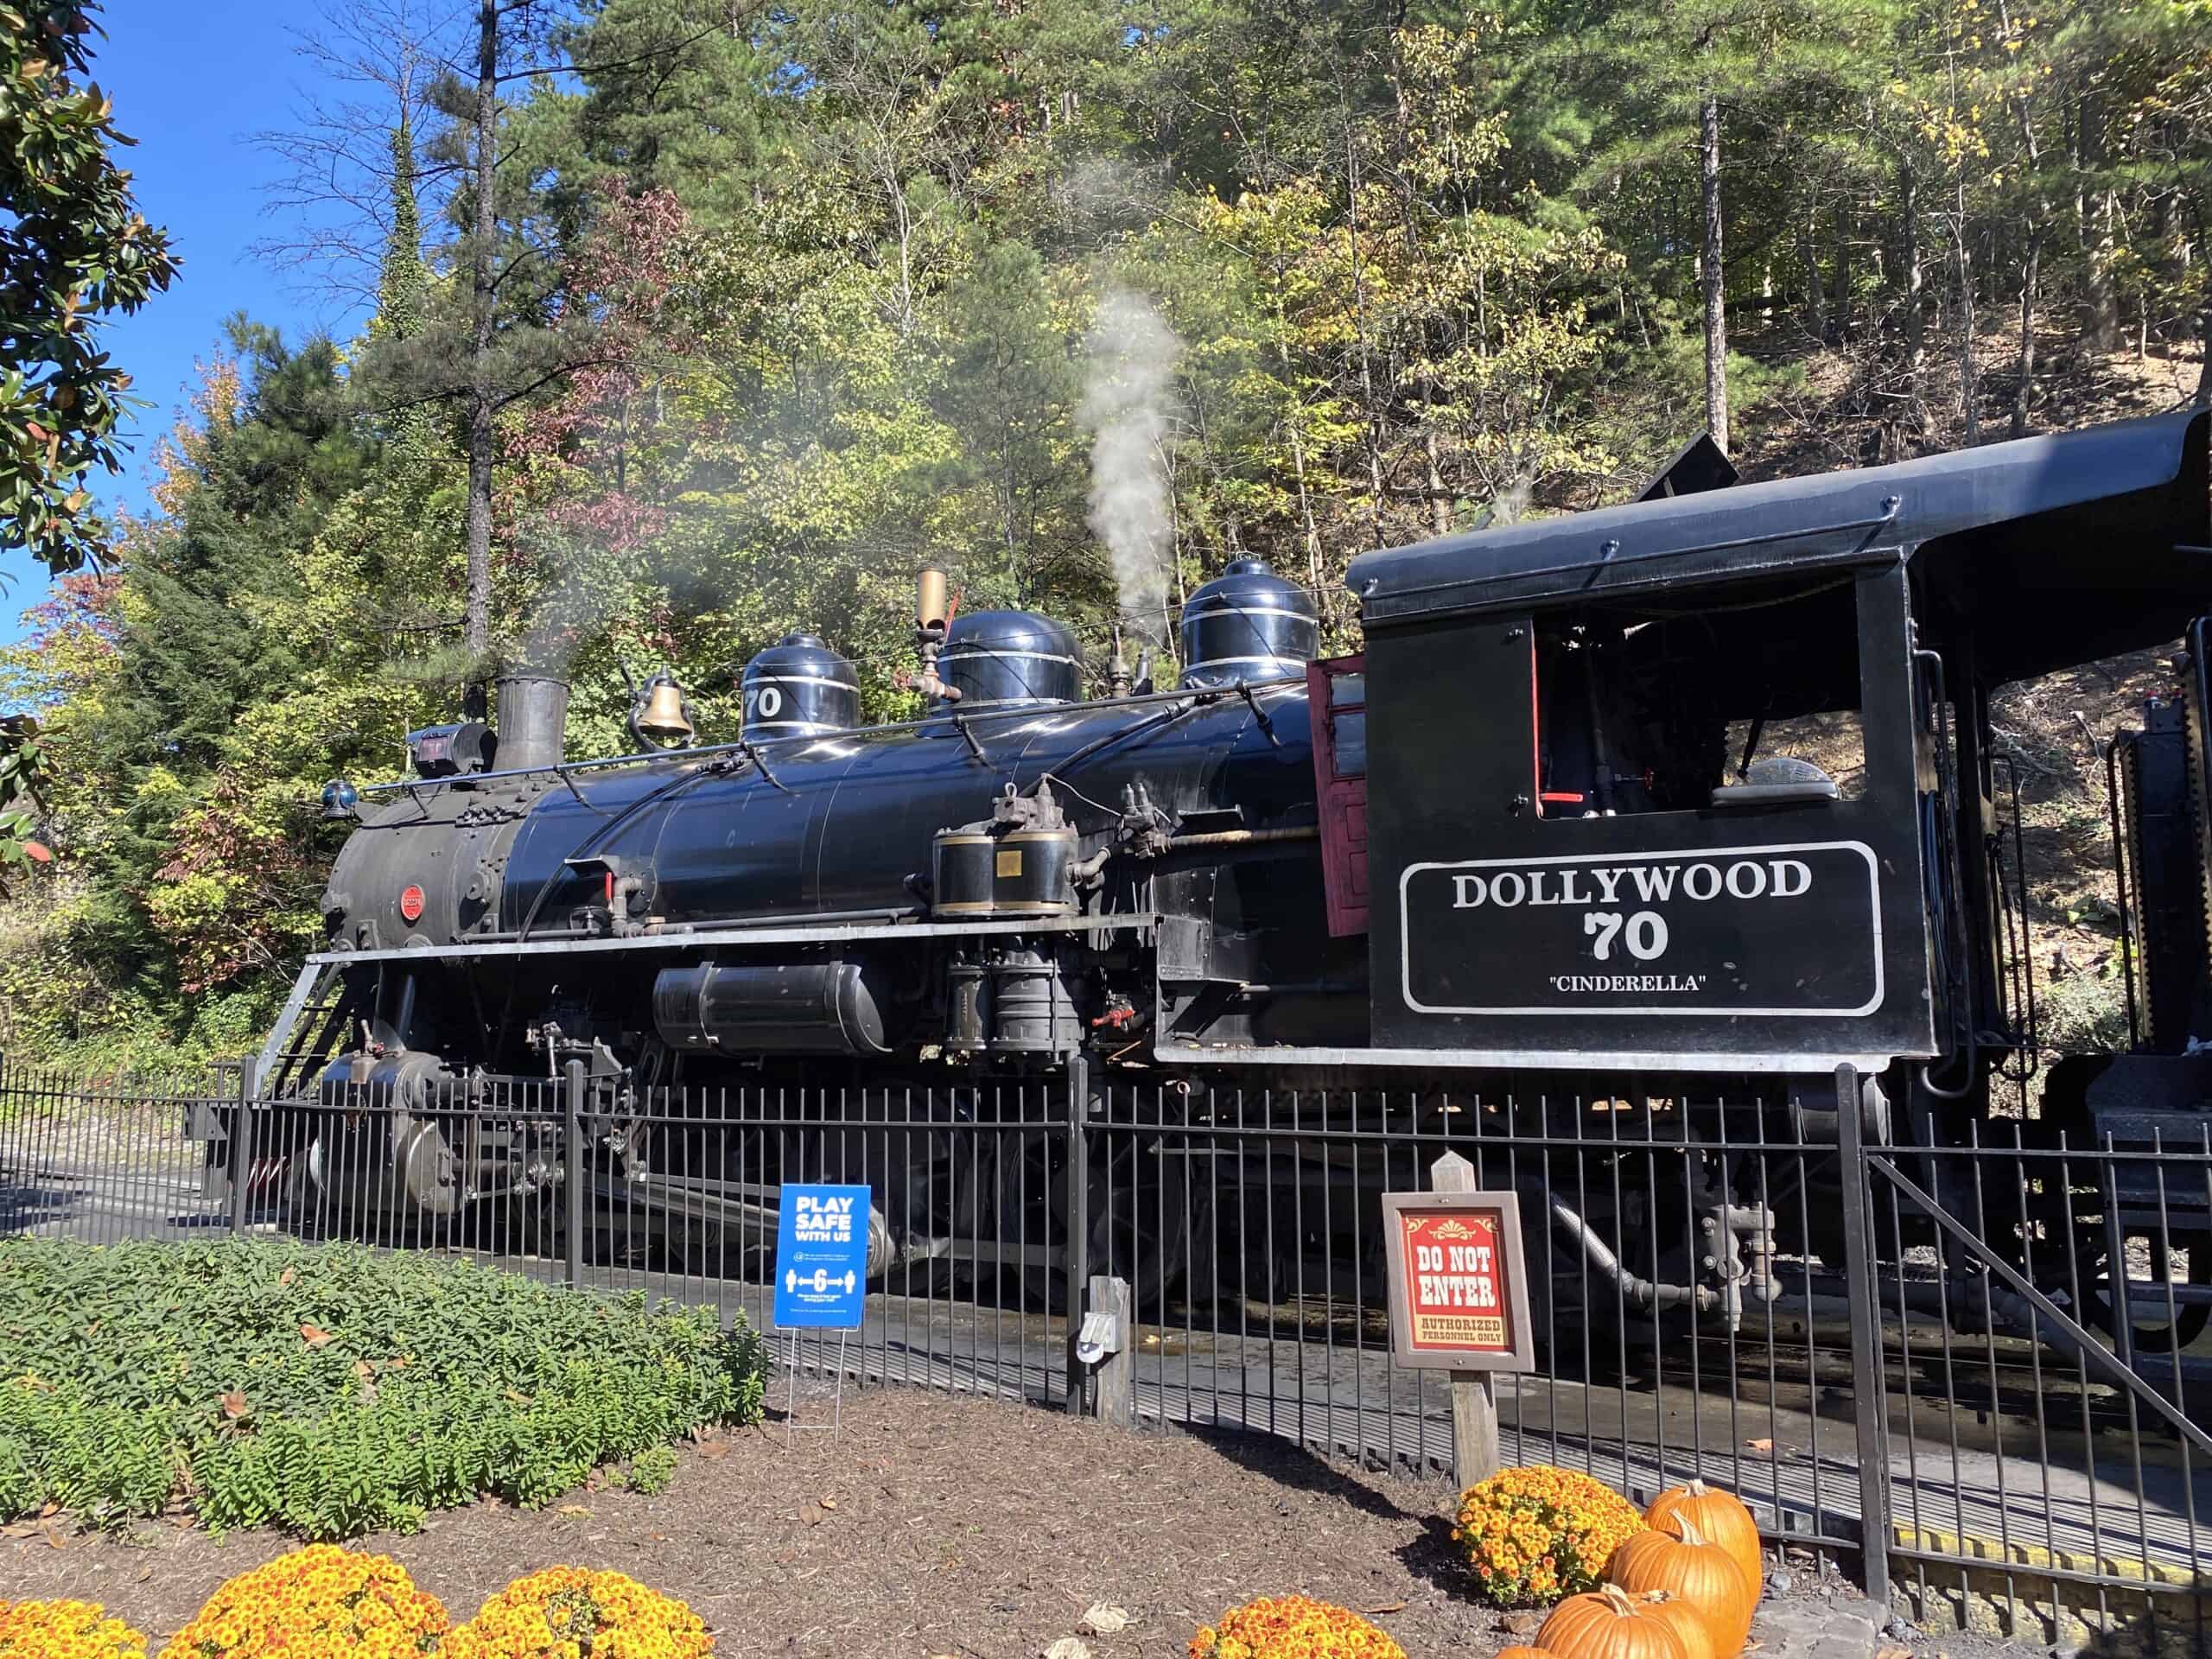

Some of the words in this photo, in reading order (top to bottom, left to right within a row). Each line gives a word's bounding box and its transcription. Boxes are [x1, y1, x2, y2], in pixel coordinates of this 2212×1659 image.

[745, 687, 782, 719] 70
[1452, 861, 1813, 908] DOLLYWOOD
[1584, 911, 1669, 960] 70
[1549, 975, 1707, 992] "CINDERELLA"
[796, 1196, 854, 1213] PLAY
[795, 1213, 852, 1230] SAFE
[795, 1230, 830, 1243] WITH
[833, 1230, 851, 1243] US
[1416, 1245, 1443, 1272] DO
[1448, 1245, 1491, 1273] NOT
[813, 1268, 828, 1292] 6
[1418, 1274, 1496, 1306] ENTER
[1421, 1318, 1501, 1332] AUTHORIZED
[1422, 1331, 1475, 1342] PERSONNEL
[1478, 1332, 1501, 1343] ONLY
